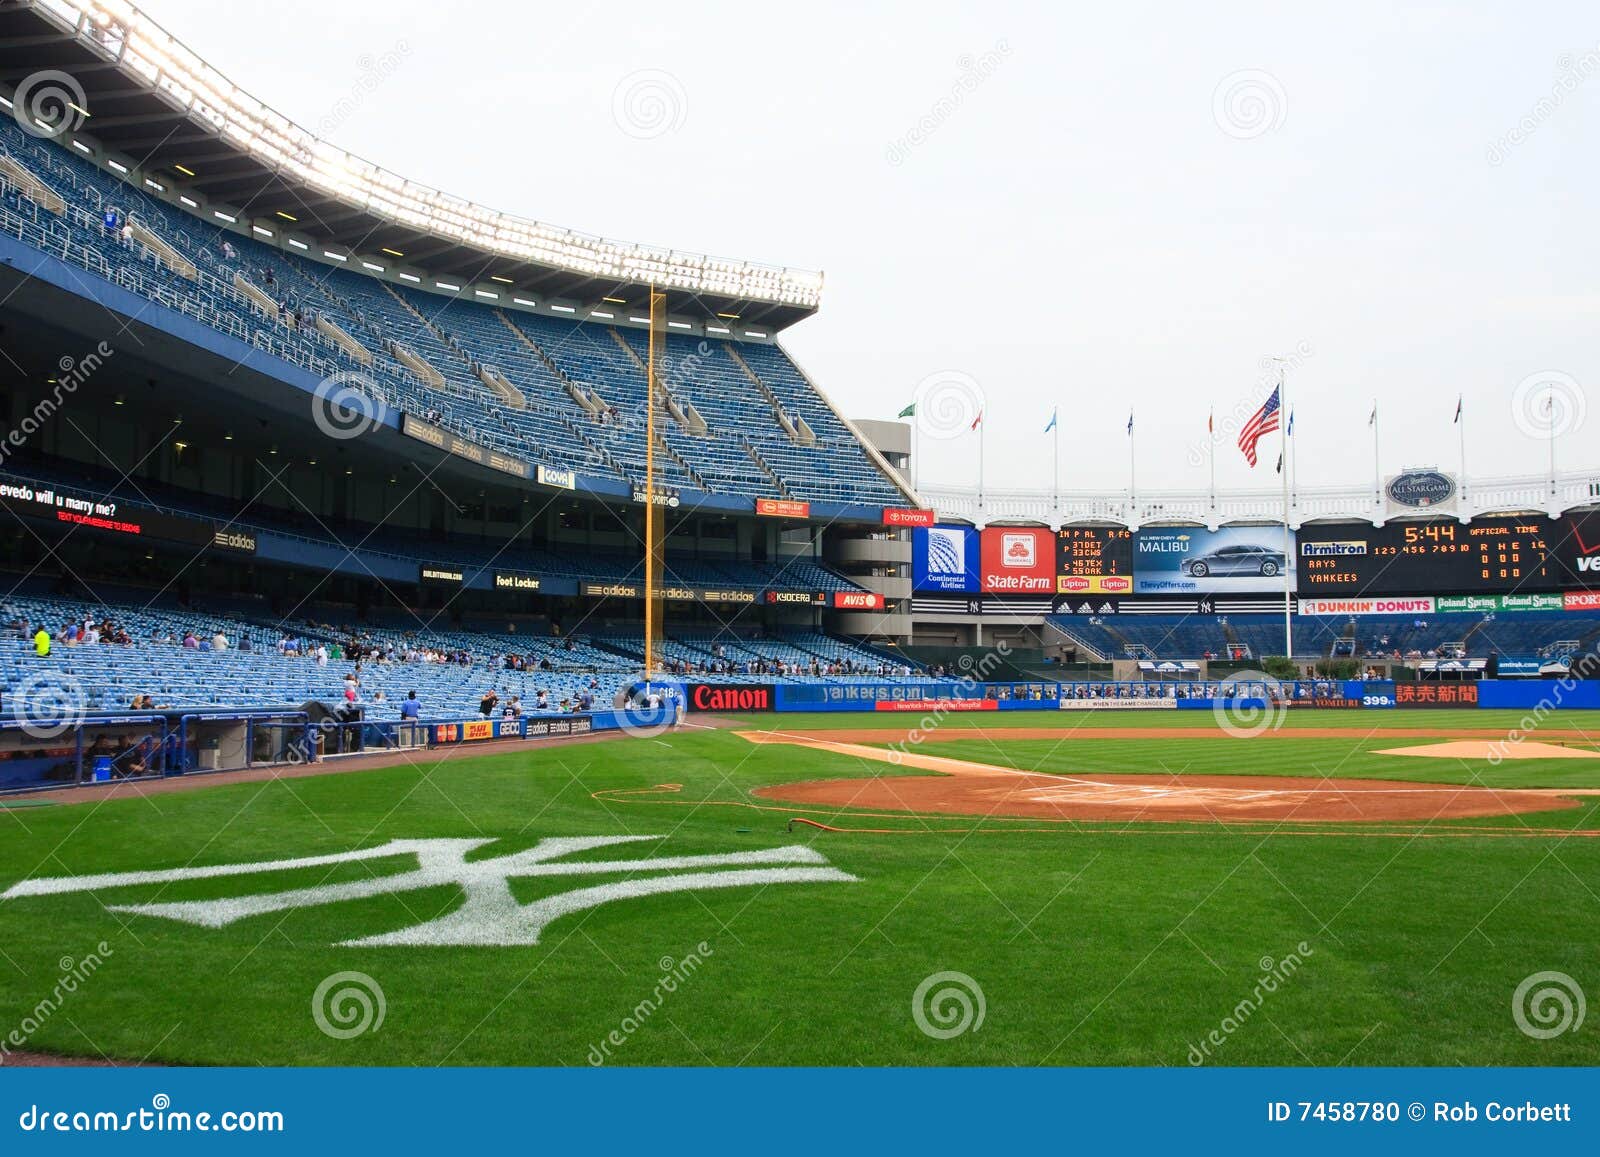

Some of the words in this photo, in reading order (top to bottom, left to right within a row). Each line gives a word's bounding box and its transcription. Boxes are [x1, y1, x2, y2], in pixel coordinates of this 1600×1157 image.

[36, 490, 53, 504] will
[56, 496, 63, 506] u
[66, 497, 94, 516] marry
[95, 503, 115, 516] me?
[900, 514, 927, 522] TOYOTA
[1405, 526, 1454, 542] 5:44
[229, 533, 255, 550] adidas
[1140, 542, 1189, 552] MALIBU
[1304, 543, 1364, 554] Armitron
[1309, 560, 1336, 568] RAYS
[496, 576, 513, 586] Foot
[515, 577, 539, 588] Locker
[928, 574, 965, 582] Continental
[1310, 574, 1358, 582] YANKEES
[1062, 580, 1088, 588] Lipton
[1102, 580, 1128, 588] Lipton
[602, 586, 635, 596] adidas
[660, 588, 694, 599] adidas
[720, 591, 754, 602] adidas
[843, 594, 865, 605] AVIS
[1438, 598, 1466, 608] Poland
[1468, 597, 1496, 608] Spring
[1502, 596, 1532, 607] Poland
[1533, 596, 1562, 607] Spring
[1318, 602, 1373, 612] DUNKIN'
[1376, 600, 1430, 612] DONUTS
[694, 685, 768, 709] Canon
[823, 686, 924, 702] yankees.com
[1363, 696, 1388, 706] 399
[500, 722, 520, 736] GEICO
[533, 721, 548, 735] adidas
[556, 720, 570, 732] adidas
[578, 719, 590, 731] adidas
